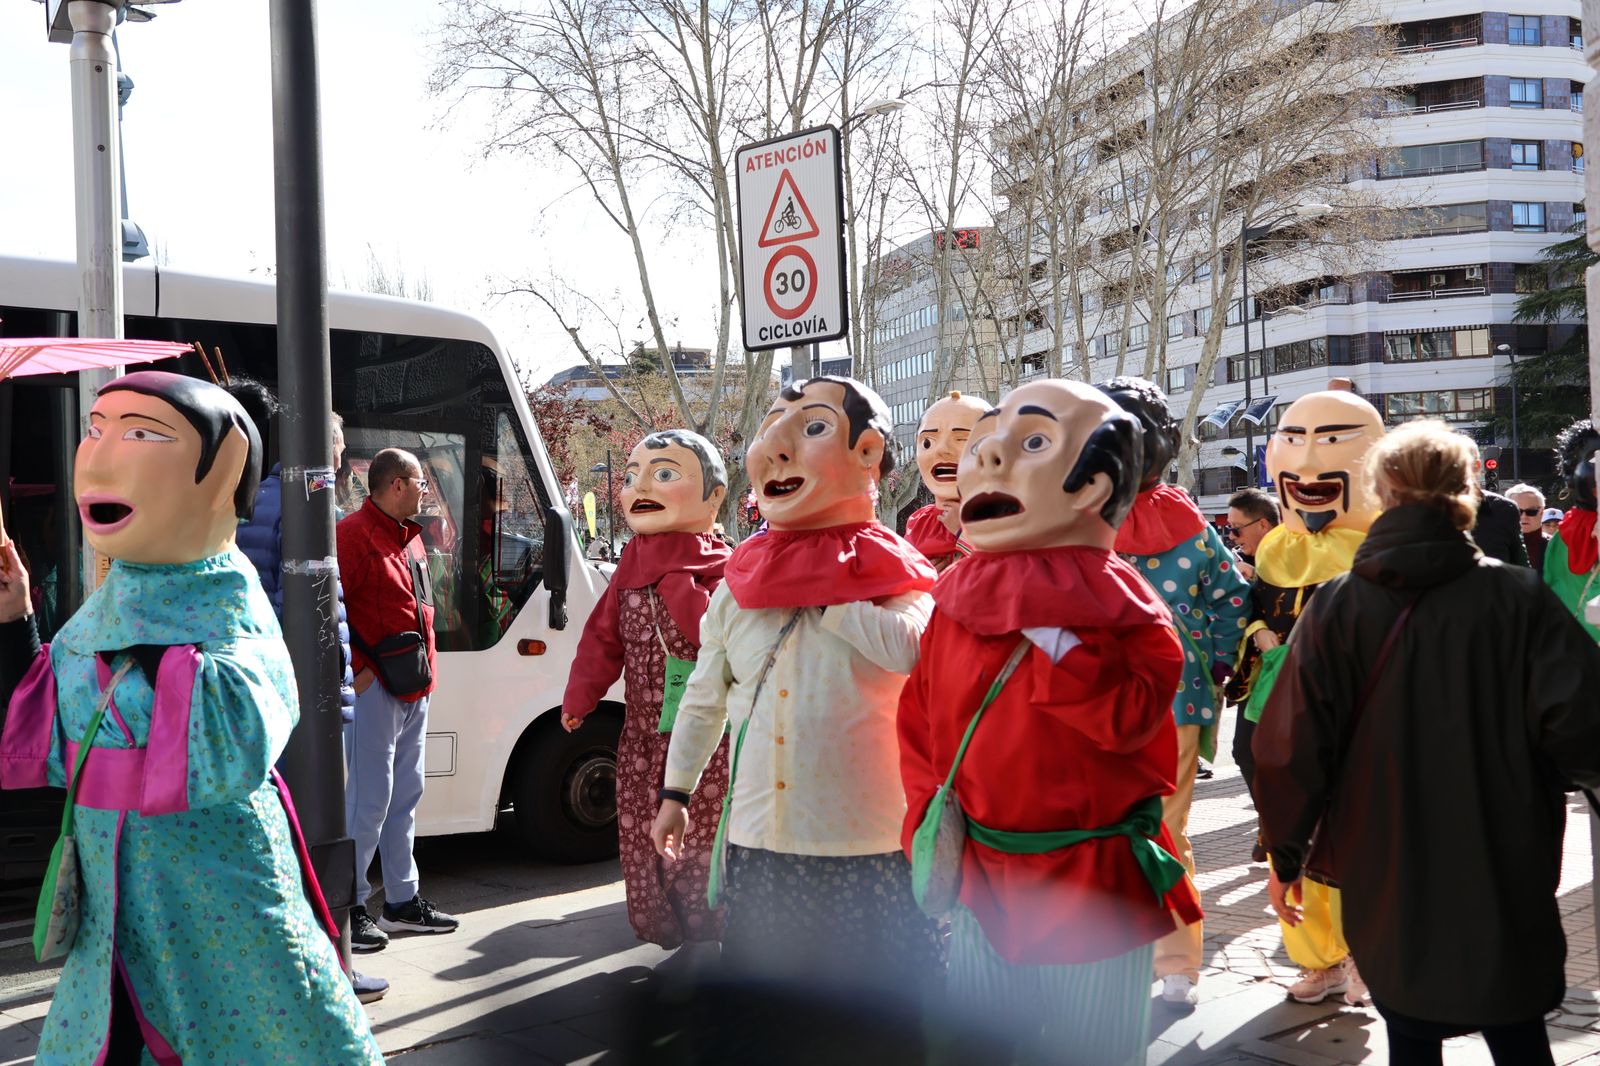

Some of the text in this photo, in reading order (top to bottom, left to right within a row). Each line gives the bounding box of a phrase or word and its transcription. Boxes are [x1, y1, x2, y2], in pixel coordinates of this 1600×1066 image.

[746, 139, 827, 172] ATENCIÓN
[775, 269, 806, 295] 30
[759, 315, 828, 341] CICLOVÍA
